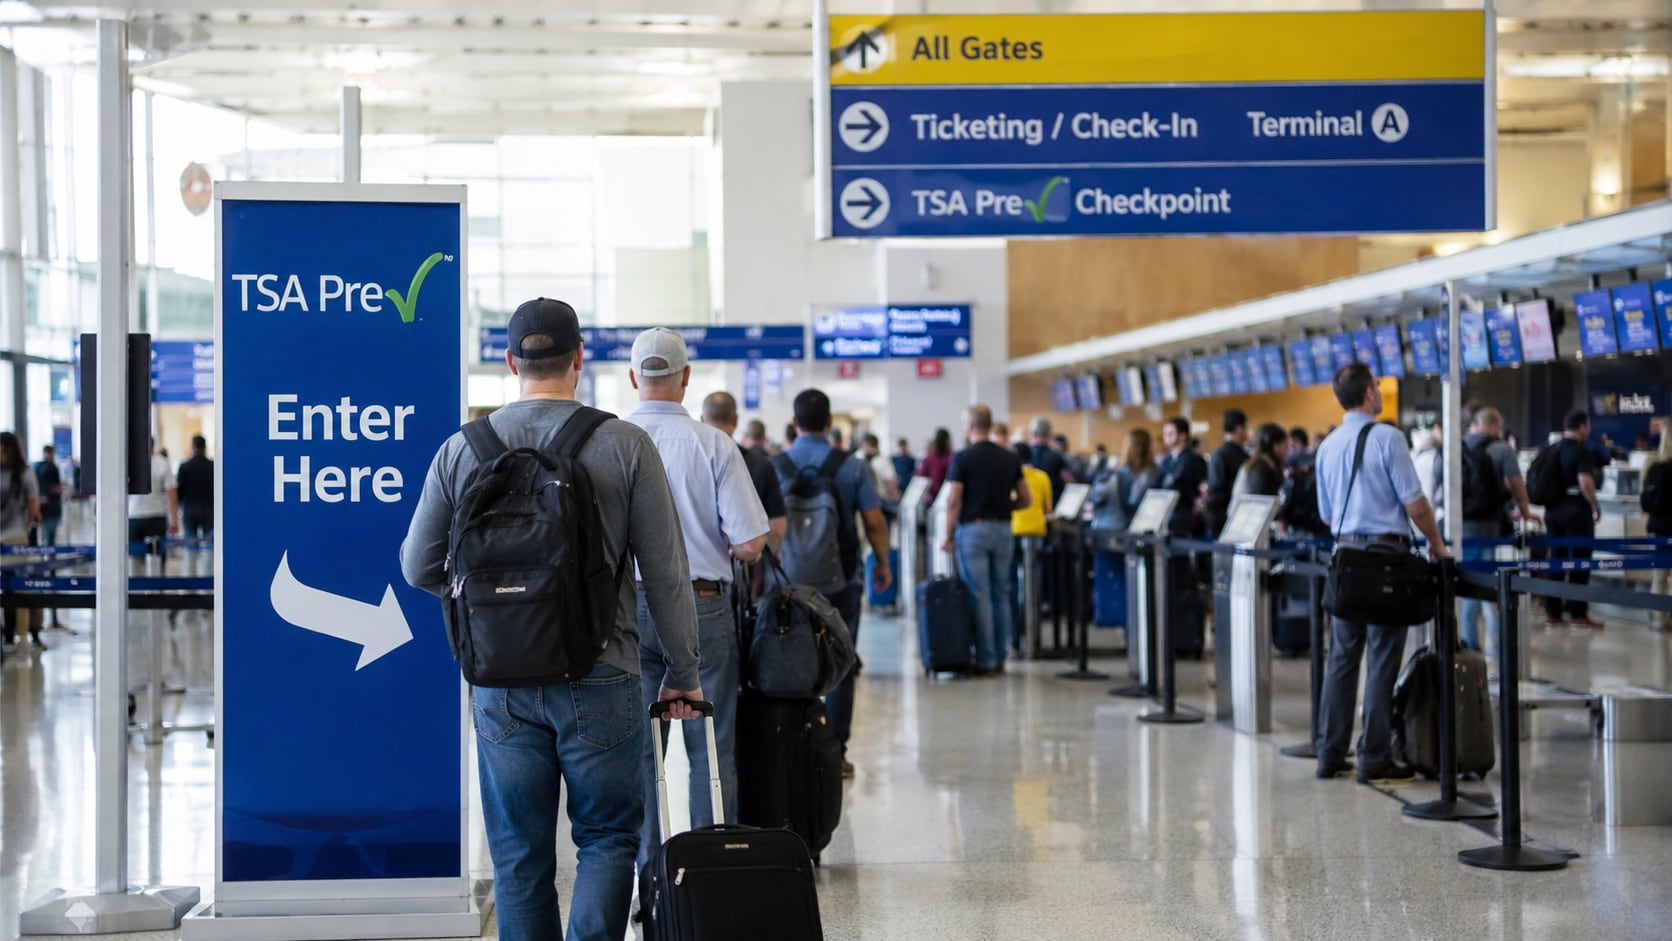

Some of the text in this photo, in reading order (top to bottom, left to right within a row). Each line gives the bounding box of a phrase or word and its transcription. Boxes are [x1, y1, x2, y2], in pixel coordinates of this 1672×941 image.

[912, 36, 1043, 61] All Gates
[911, 112, 1199, 145] Ticketing / Check-In
[1247, 109, 1401, 137] Terminal A
[912, 187, 1231, 219] TSA Pre Checkpoint
[231, 273, 383, 313] TSA Pre
[268, 394, 415, 441] Enter
[273, 455, 404, 503] Here
